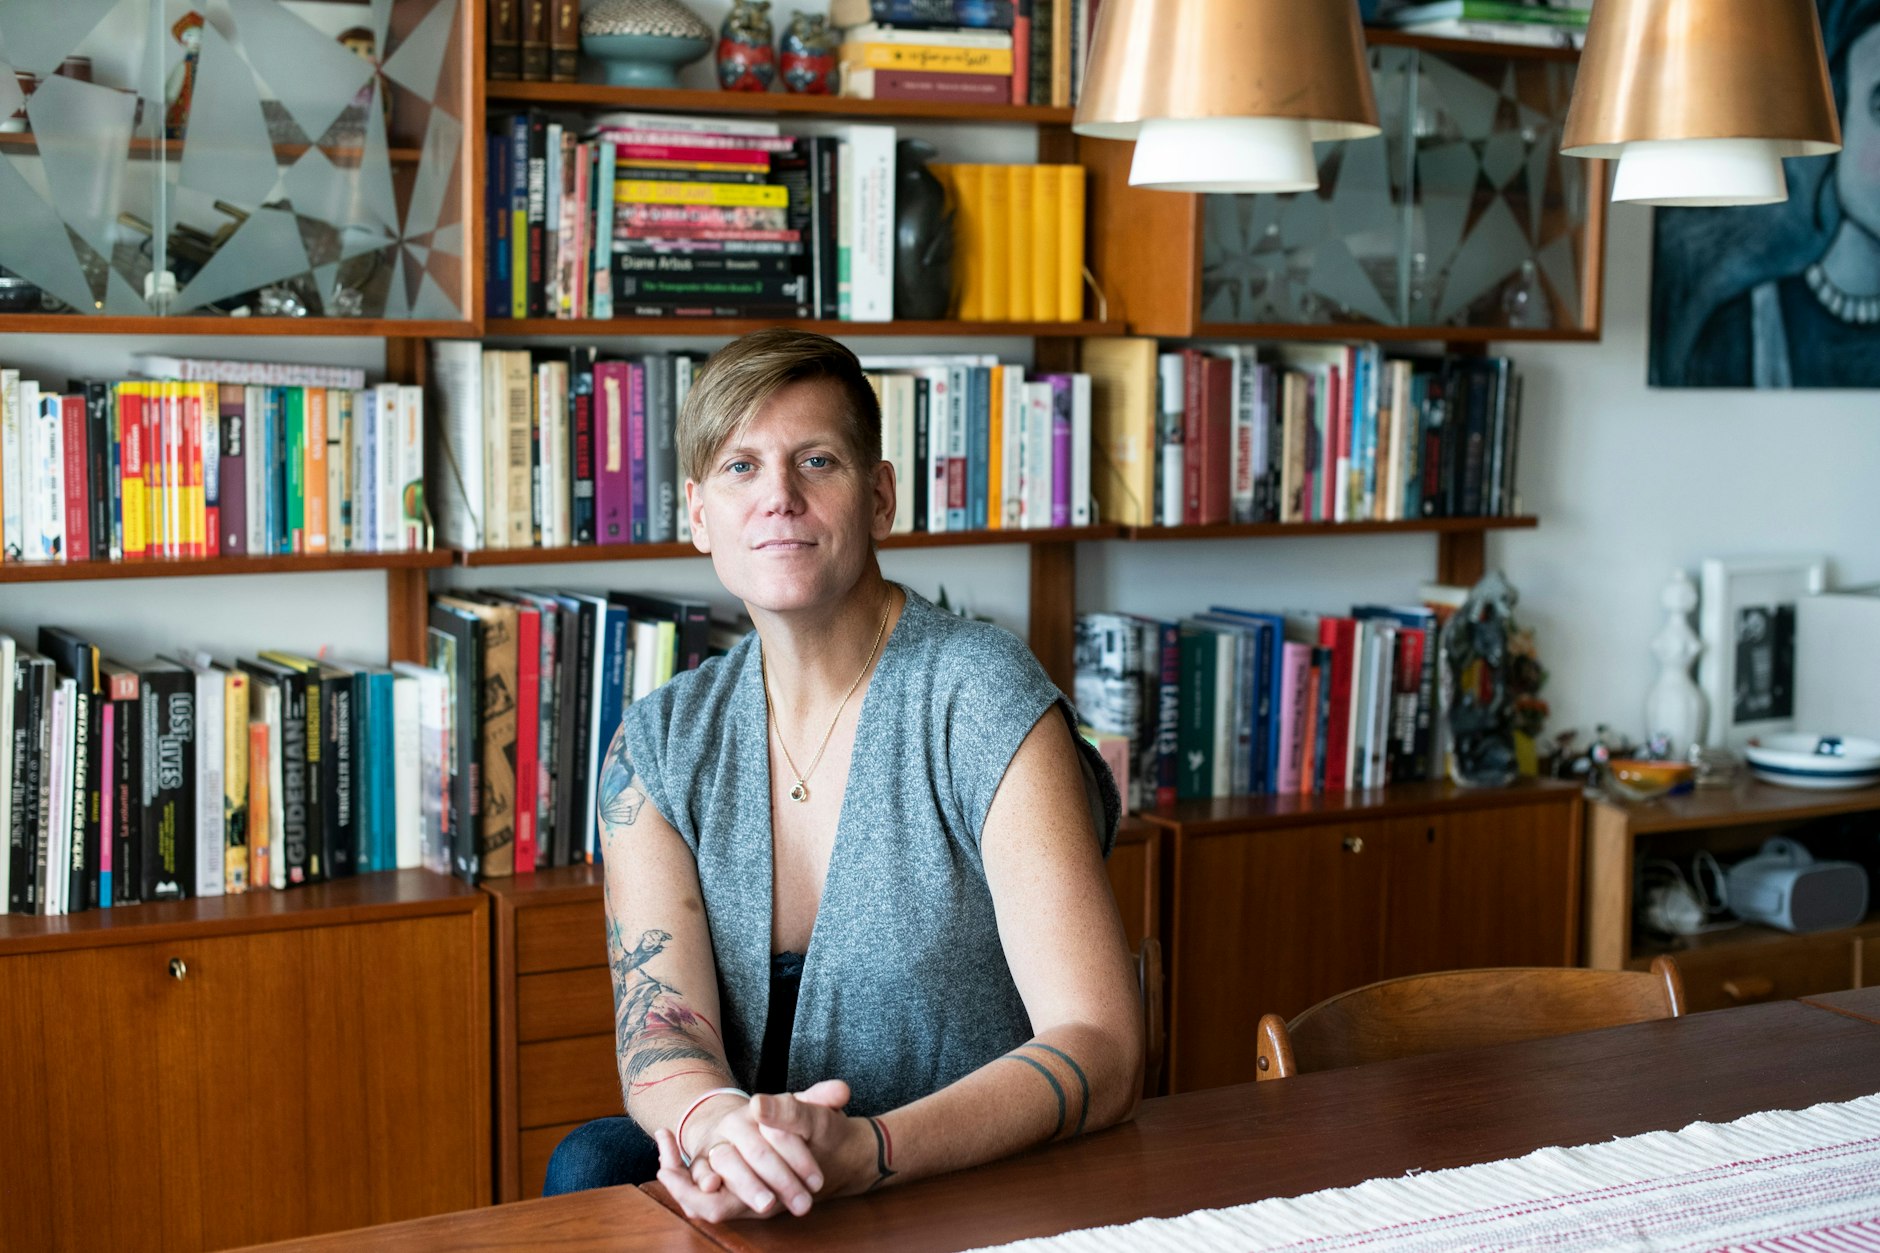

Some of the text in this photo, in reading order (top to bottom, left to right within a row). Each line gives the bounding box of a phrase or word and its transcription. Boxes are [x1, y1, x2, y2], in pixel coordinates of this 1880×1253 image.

[529, 157, 545, 224] STONEWALL
[621, 255, 693, 271] Diane Arbus
[169, 693, 193, 742] LOST
[1159, 685, 1178, 755] EAGLES
[28, 760, 39, 821] TATTOO
[158, 736, 183, 790] LIVES
[120, 784, 129, 824] voluntad
[285, 719, 306, 865] GUDERIAN
[38, 786, 50, 867] PIERCING
[120, 825, 129, 838] La
